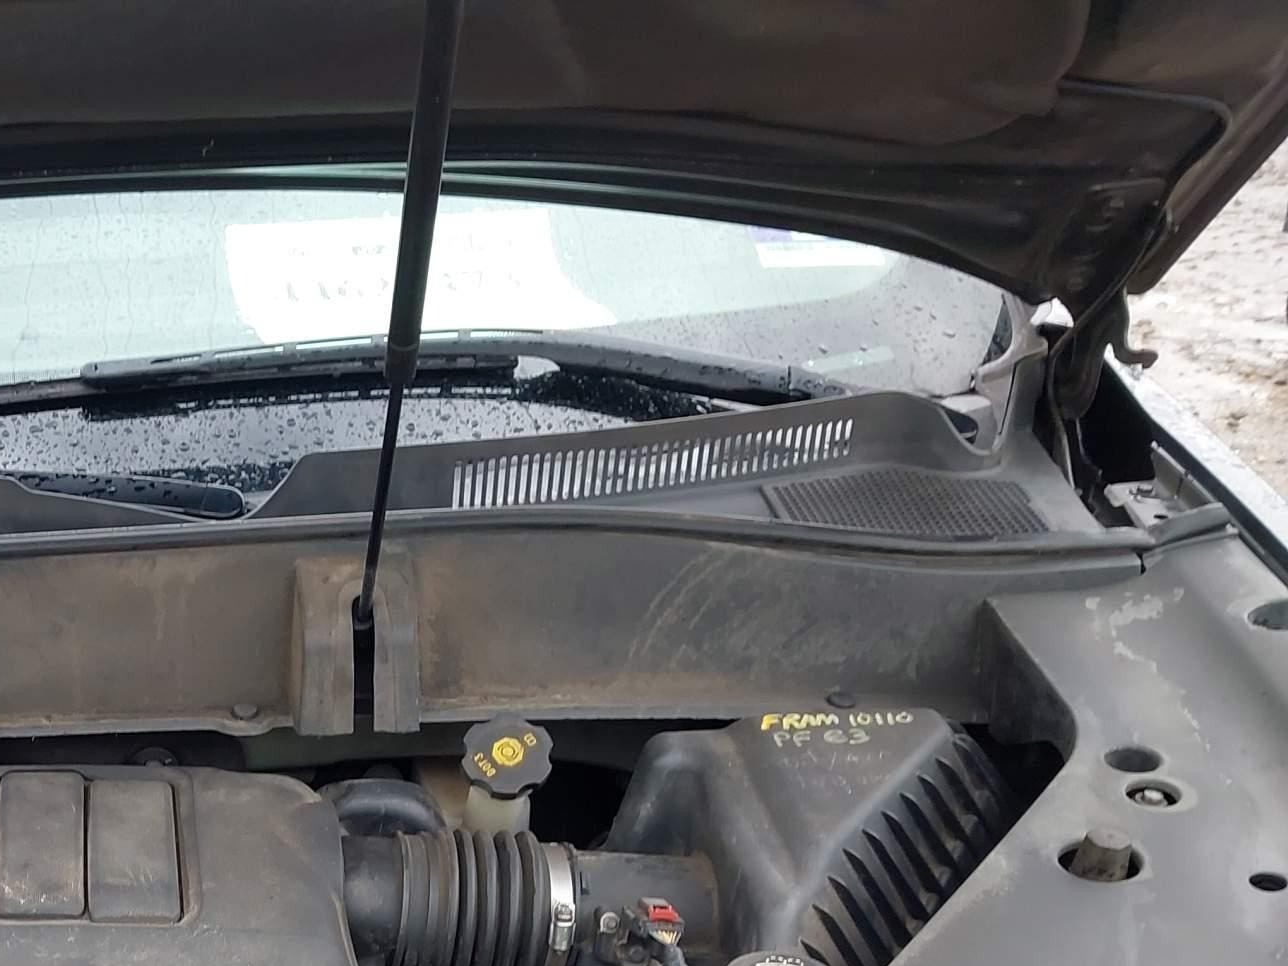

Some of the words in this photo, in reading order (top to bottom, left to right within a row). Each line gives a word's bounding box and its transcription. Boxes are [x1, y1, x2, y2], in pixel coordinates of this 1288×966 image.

[761, 712, 840, 730] FRAM
[848, 711, 913, 726] 10110
[772, 730, 811, 748] PF
